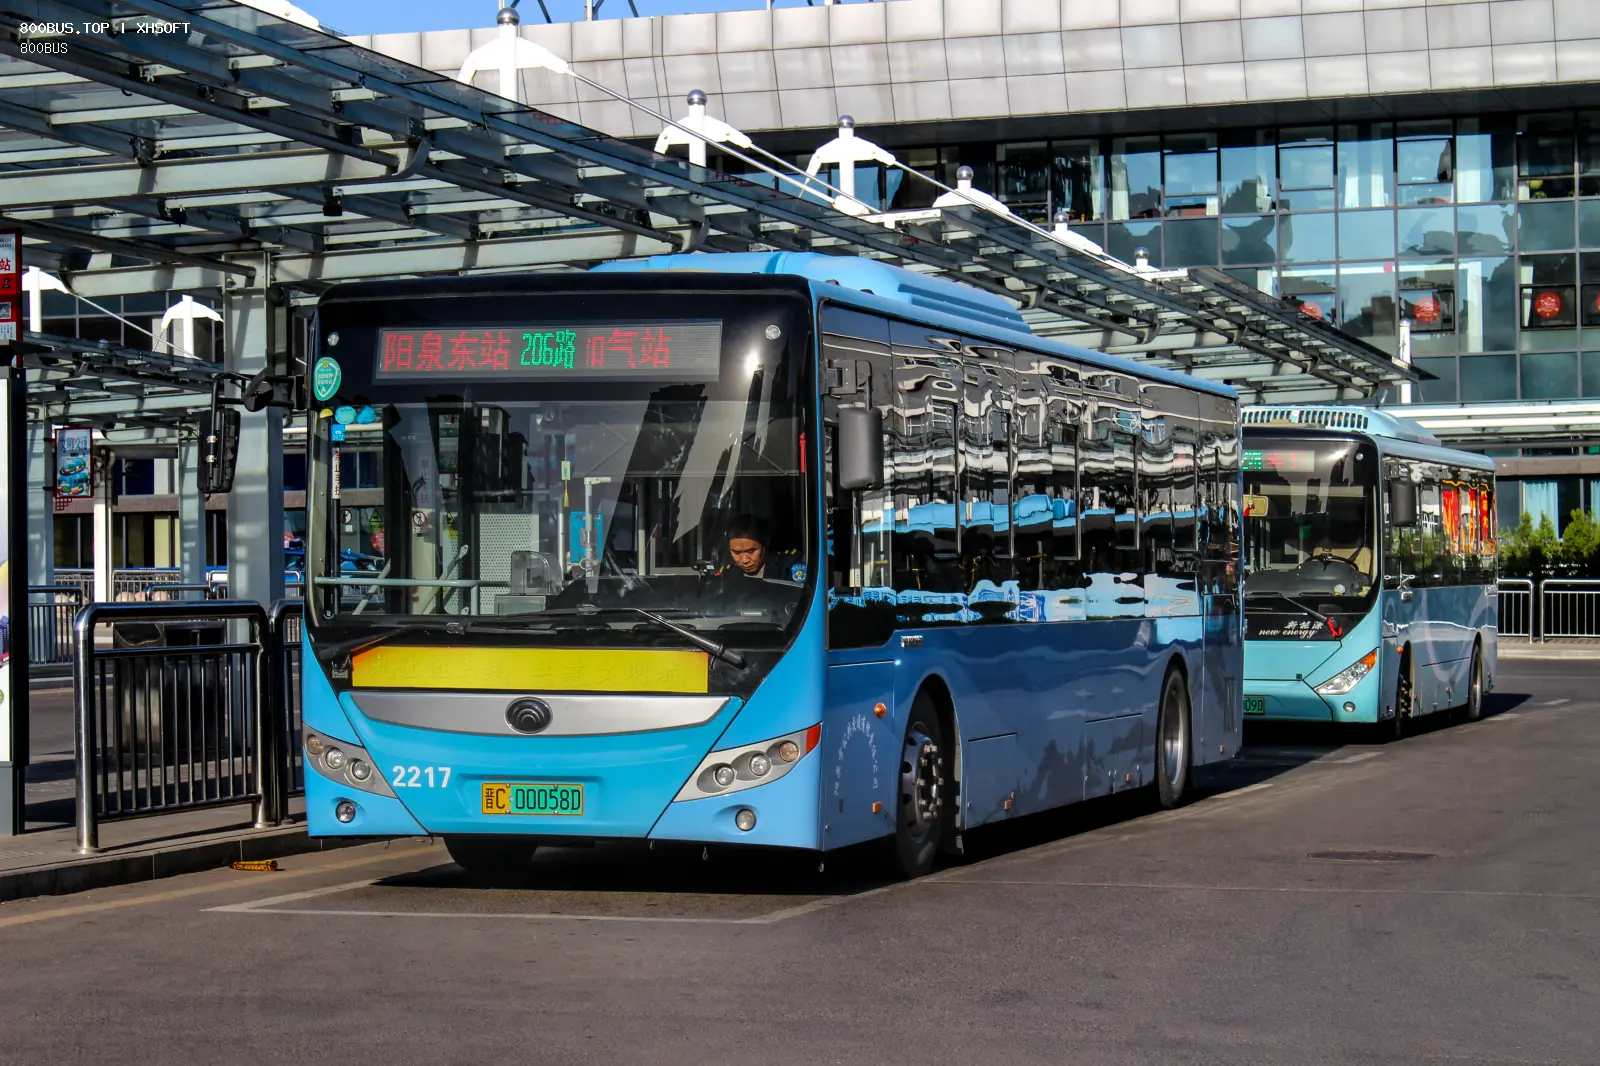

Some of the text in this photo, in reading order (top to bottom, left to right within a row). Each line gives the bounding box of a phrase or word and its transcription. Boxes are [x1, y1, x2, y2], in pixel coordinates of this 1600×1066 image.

[383, 330, 511, 372] 阳泉东站
[520, 328, 577, 369] 206路
[1282, 629, 1318, 639] energy
[392, 765, 451, 788] 2217
[484, 787, 506, 810] 晋C
